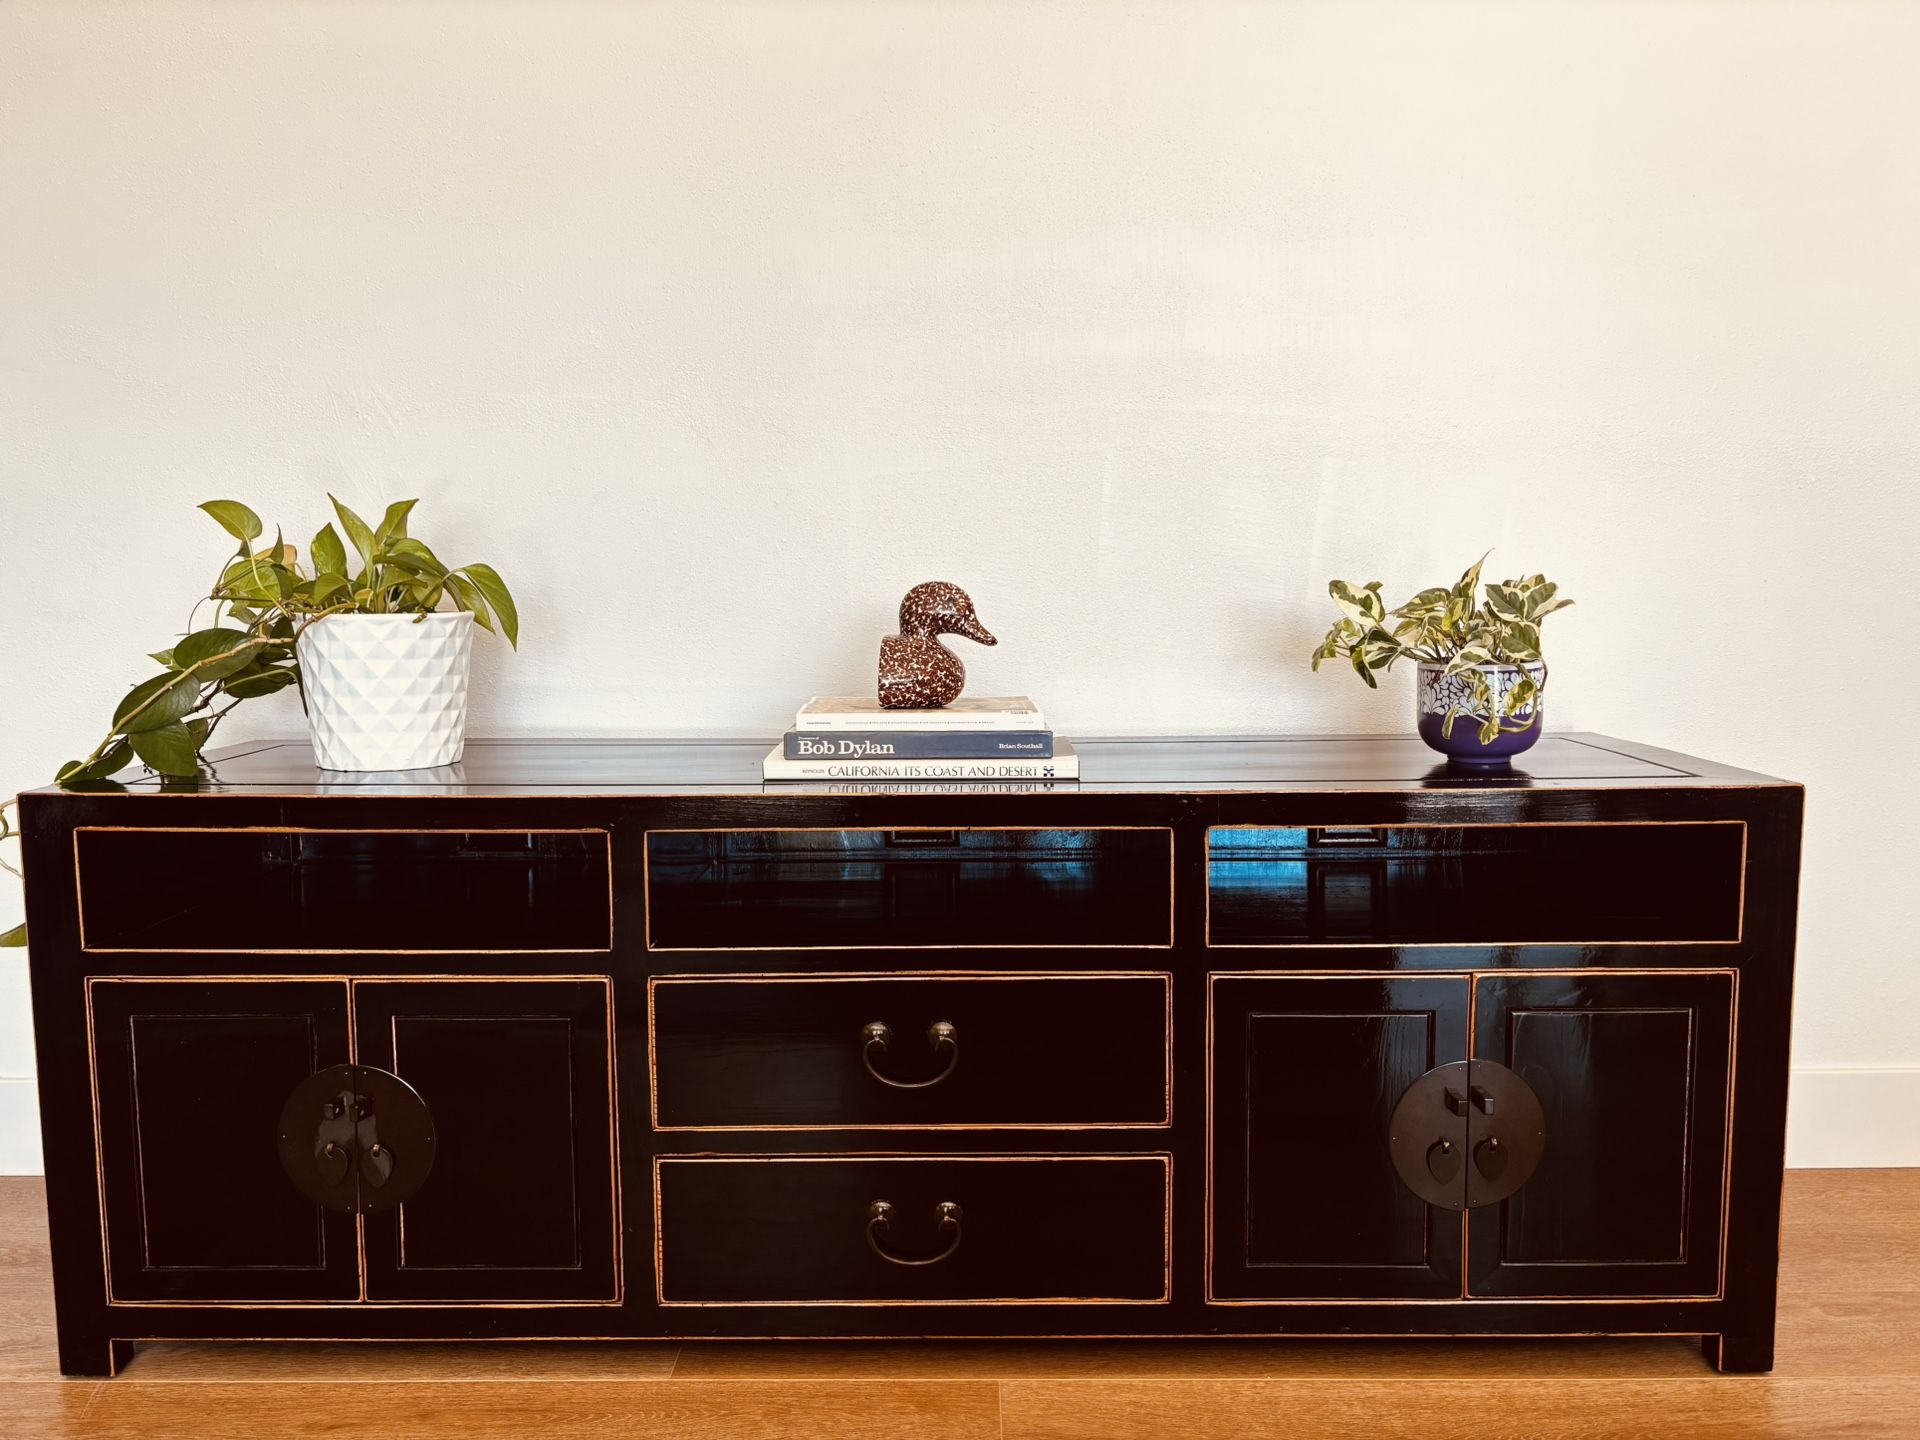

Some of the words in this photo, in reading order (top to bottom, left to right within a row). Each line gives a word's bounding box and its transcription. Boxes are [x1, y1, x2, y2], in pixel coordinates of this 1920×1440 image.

[797, 740, 835, 755] Bob
[838, 740, 895, 758] Dylan
[828, 765, 900, 777] CALIFORNIA
[904, 765, 921, 777] ITS
[924, 765, 965, 777] COAST
[967, 765, 996, 777] AND
[999, 765, 1038, 777] DESERT
